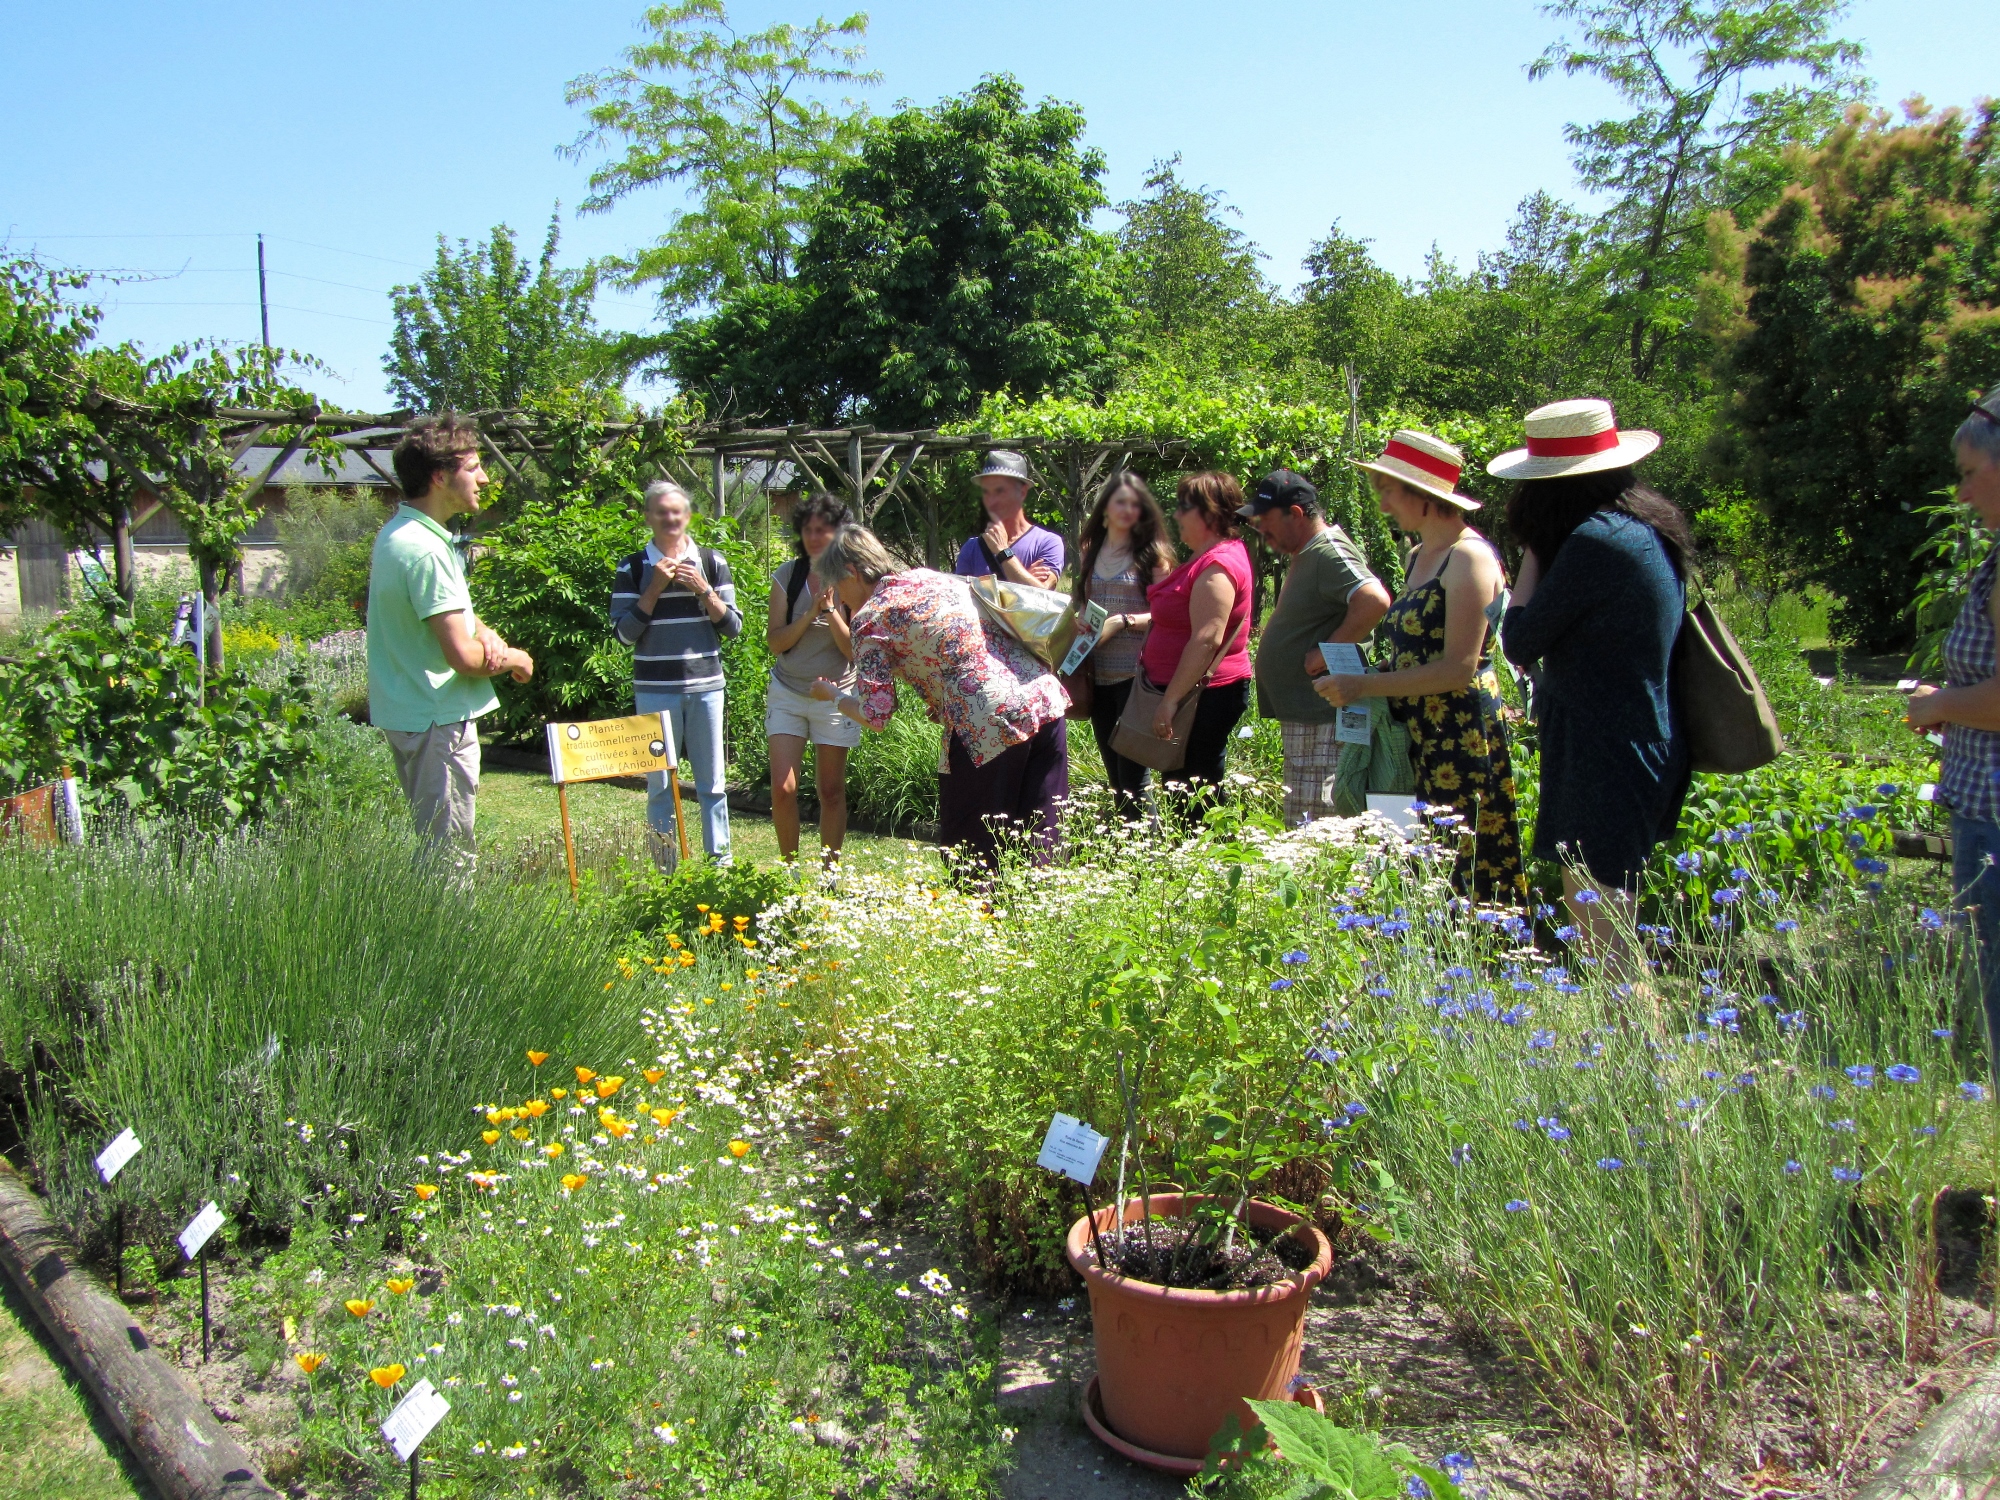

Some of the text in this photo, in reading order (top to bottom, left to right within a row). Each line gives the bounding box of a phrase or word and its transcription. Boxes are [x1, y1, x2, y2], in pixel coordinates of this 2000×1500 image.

[588, 723, 625, 735] Plantes
[566, 731, 658, 750] traditionnellement
[585, 749, 629, 762] cultivées
[572, 758, 657, 777] Chemillé (Anjou)
